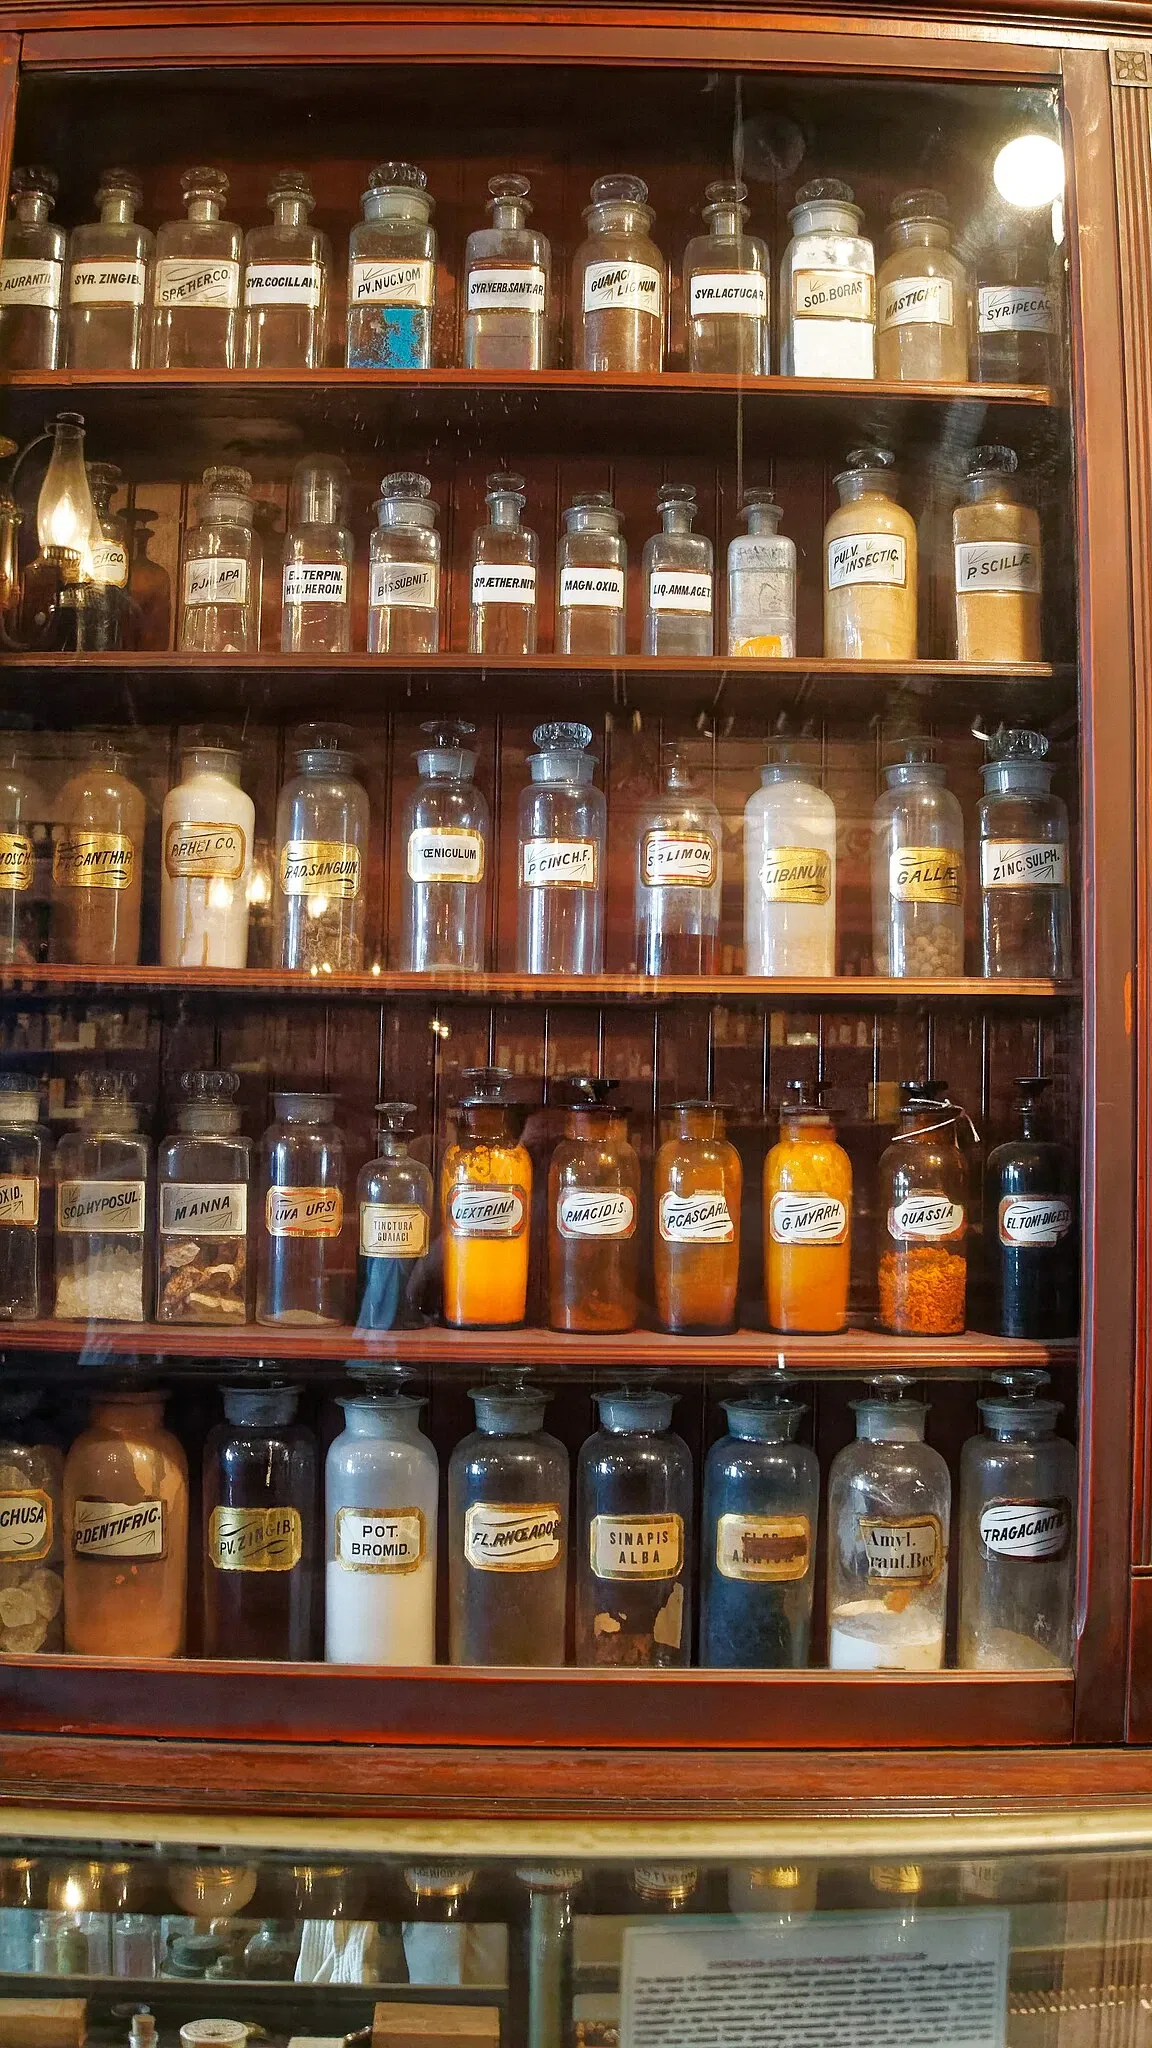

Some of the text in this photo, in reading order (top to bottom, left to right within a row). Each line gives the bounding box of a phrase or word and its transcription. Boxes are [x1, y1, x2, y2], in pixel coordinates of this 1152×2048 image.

[0, 273, 51, 290] AURANTII
[75, 275, 97, 285] SYR.
[833, 544, 858, 569] PULV.
[846, 549, 899, 574] INSECTIC.
[564, 580, 620, 593] MAGN.OXID.
[215, 837, 236, 852] CO.
[0, 1186, 23, 1204] XID.
[174, 1196, 230, 1221] MANNA
[275, 1200, 336, 1221] UVA URSI
[455, 1200, 515, 1220] DEXTRINA
[901, 1206, 954, 1227] QUASSIA
[373, 1221, 413, 1231] TINCTURA
[377, 1232, 409, 1242] GUAIACI
[362, 1525, 399, 1538] POT.
[609, 1531, 669, 1545] SINAPIS
[351, 1543, 411, 1557] BROMID.
[618, 1550, 660, 1565] ALBA
